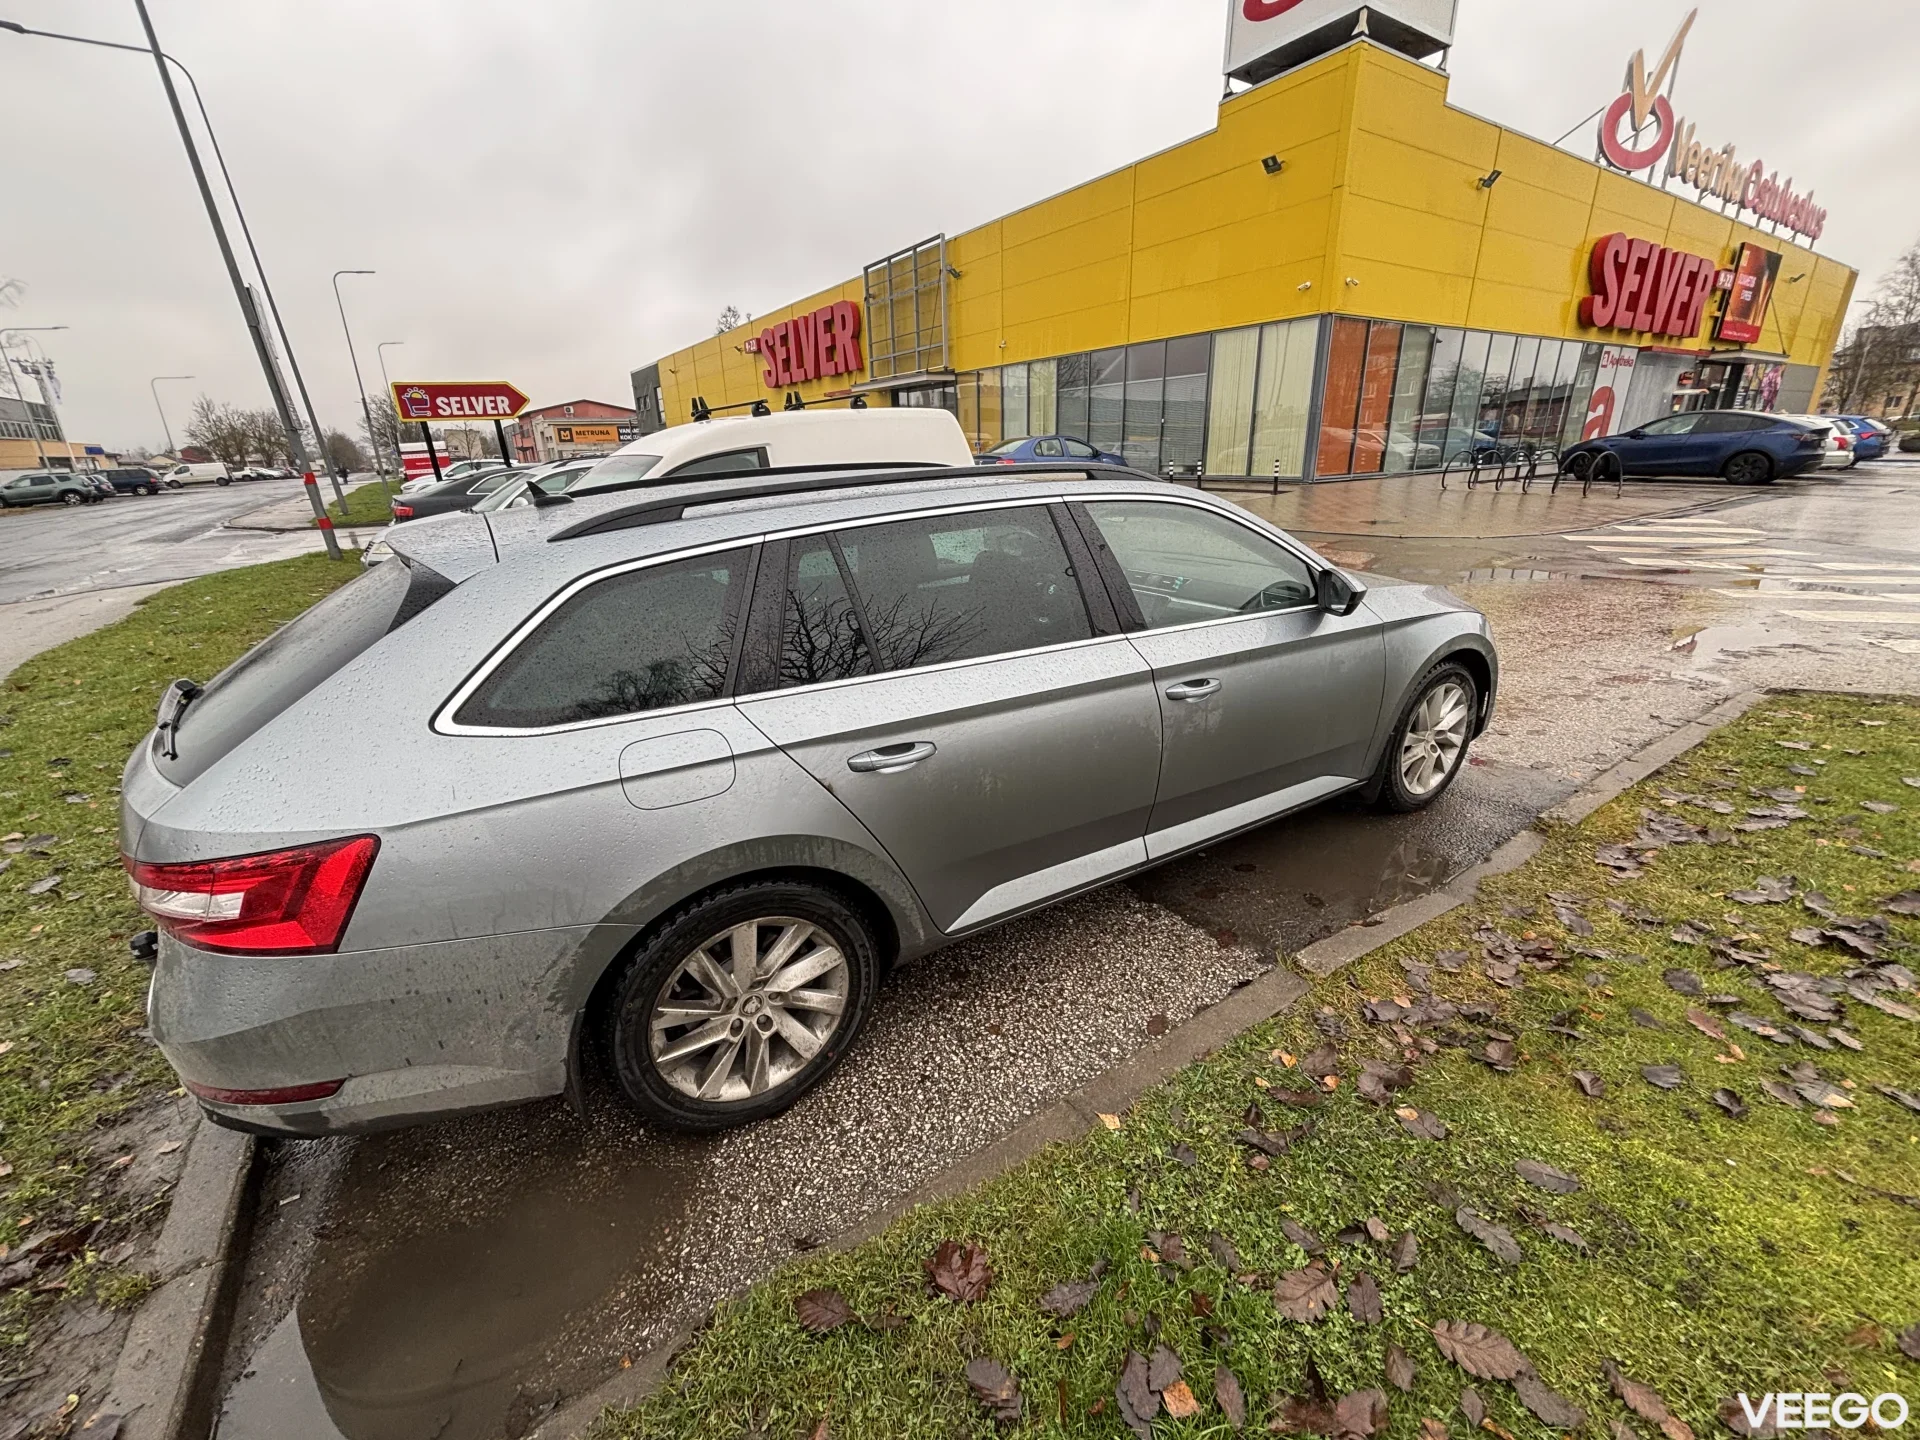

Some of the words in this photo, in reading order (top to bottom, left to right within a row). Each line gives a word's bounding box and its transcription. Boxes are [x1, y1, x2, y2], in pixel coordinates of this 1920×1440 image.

[1588, 232, 1715, 338] SELVER
[760, 300, 862, 388] SELVER
[436, 396, 512, 416] SELVER
